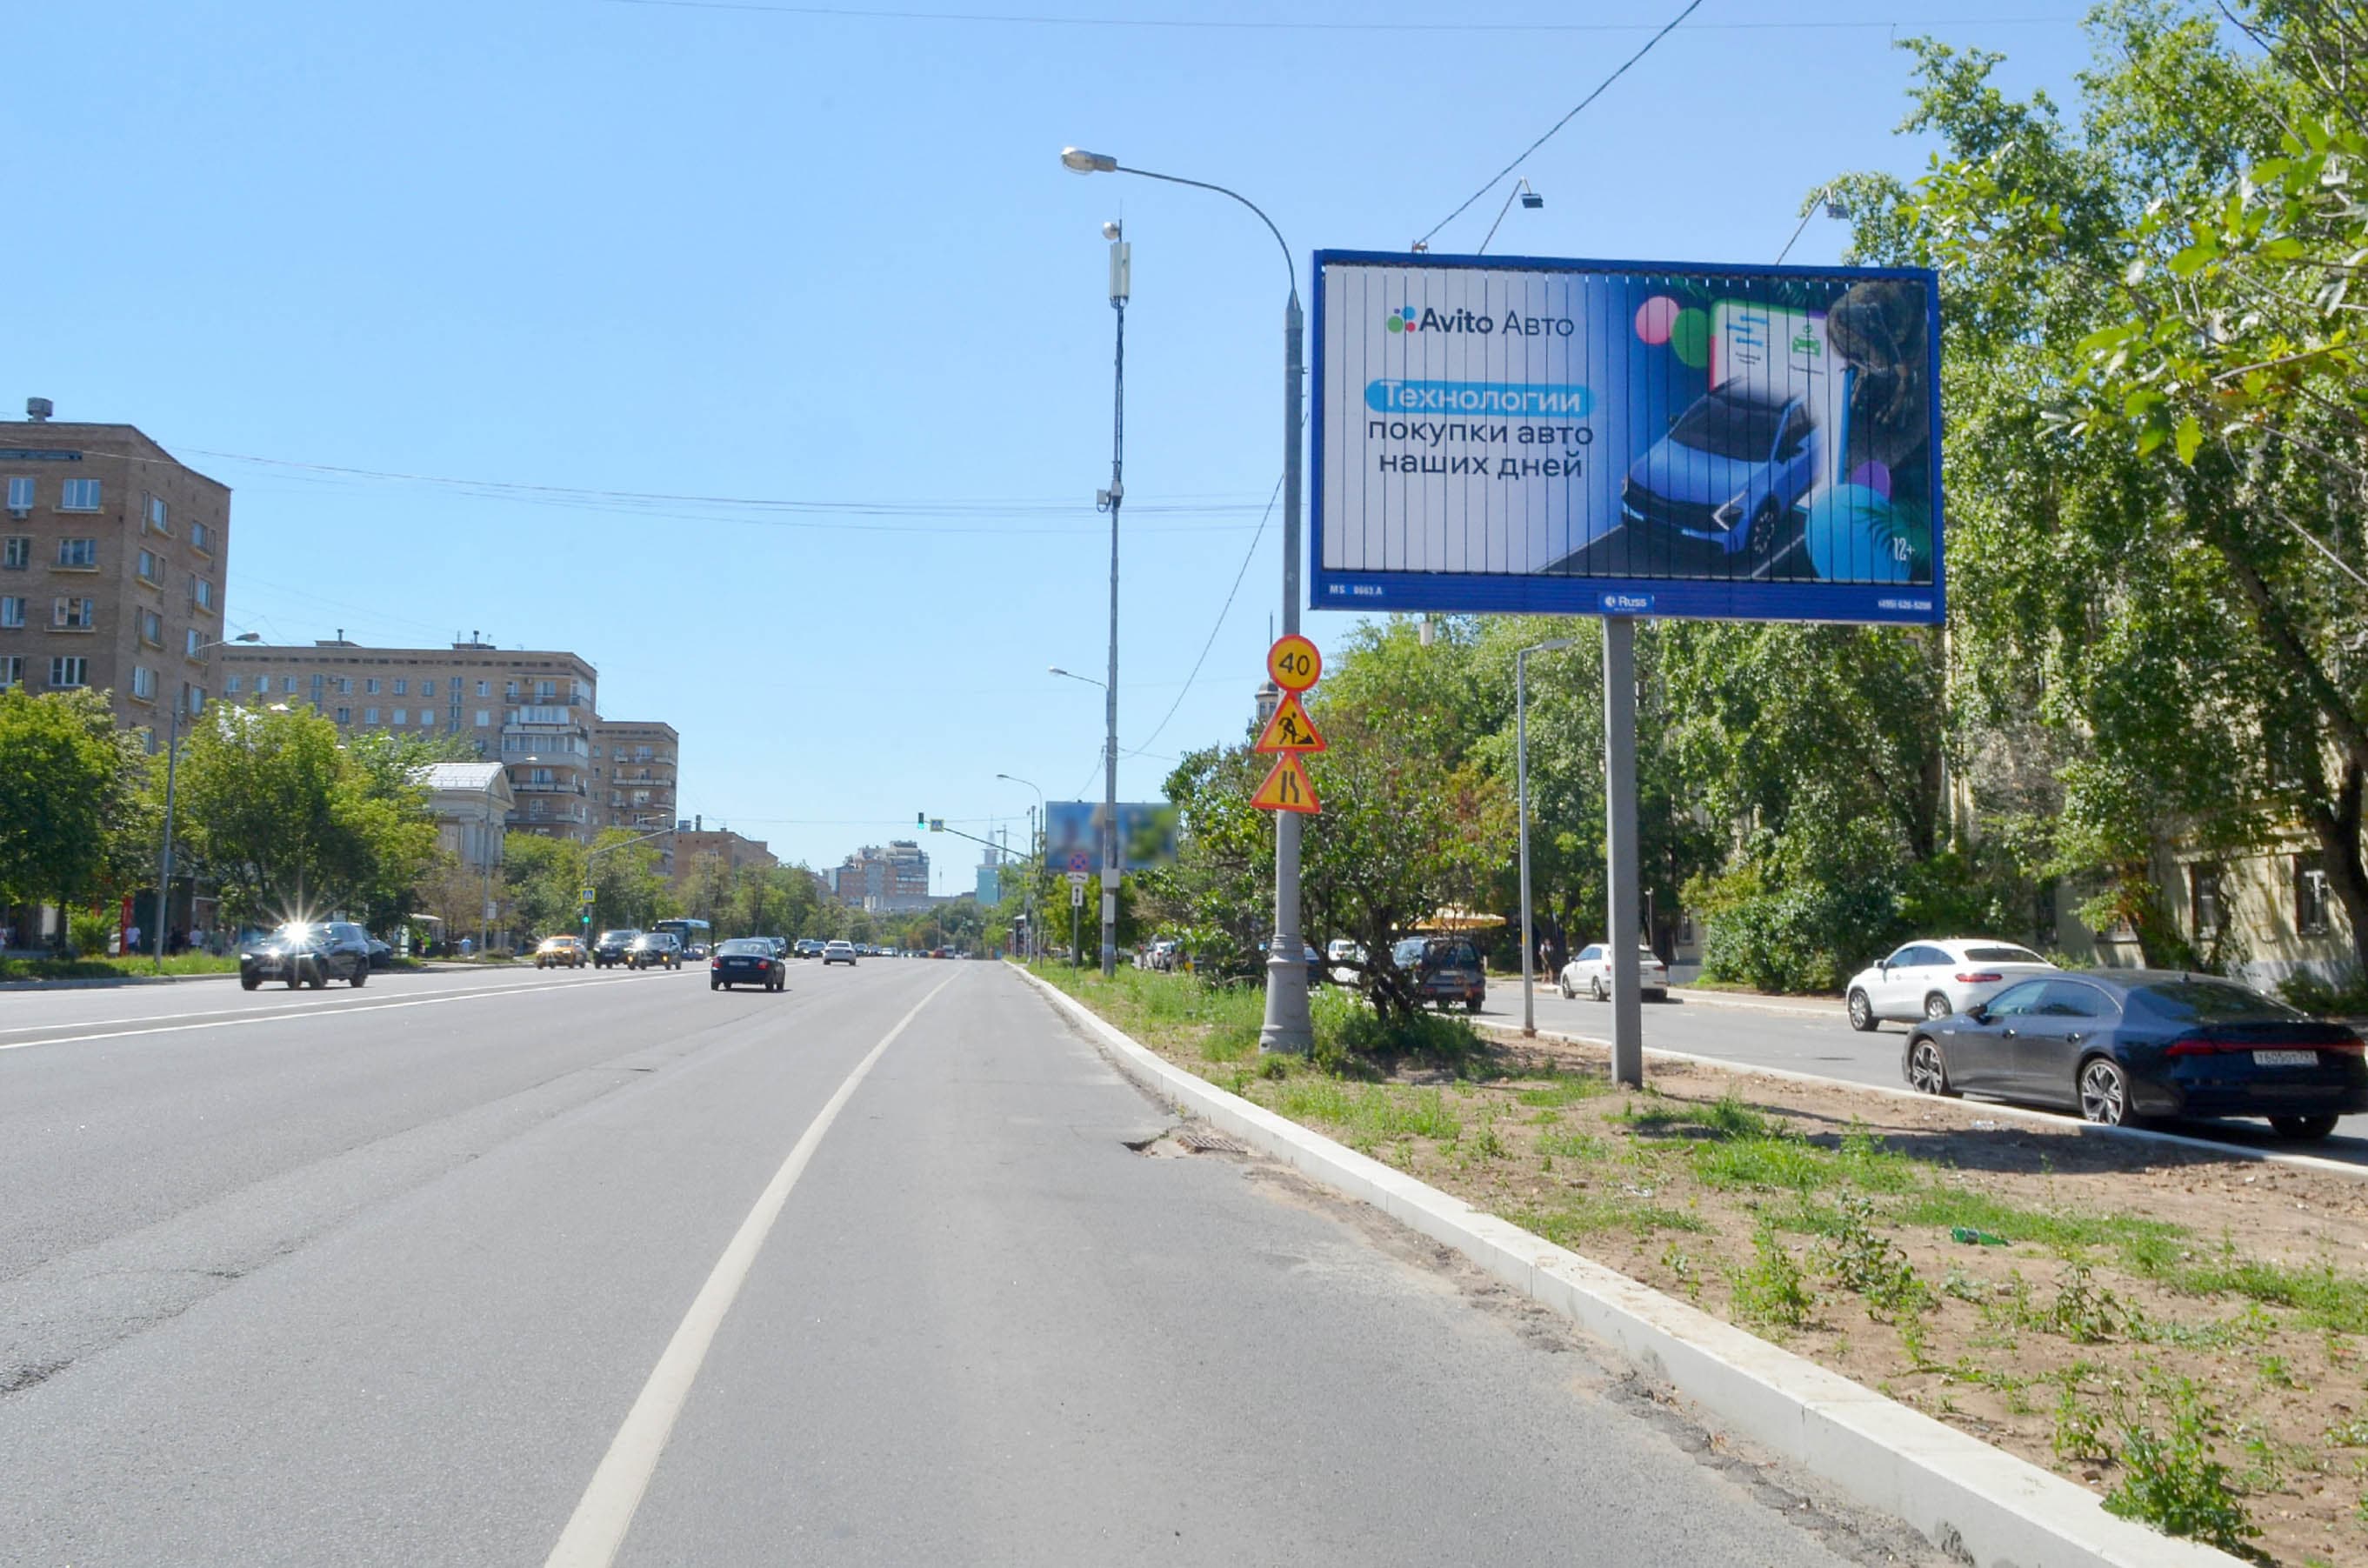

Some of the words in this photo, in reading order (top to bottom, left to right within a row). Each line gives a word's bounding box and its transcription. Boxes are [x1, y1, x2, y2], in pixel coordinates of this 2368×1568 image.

[1418, 308, 1493, 334] Avito
[1502, 310, 1575, 337] Авто
[1379, 380, 1581, 413] Технологии
[1369, 421, 1508, 447] покупки
[1517, 424, 1594, 445] авто
[1379, 453, 1490, 476] наших
[1497, 450, 1582, 481] дней
[1893, 537, 1916, 561] 12+
[1618, 596, 1647, 608] Russ
[1278, 651, 1311, 677] 40
